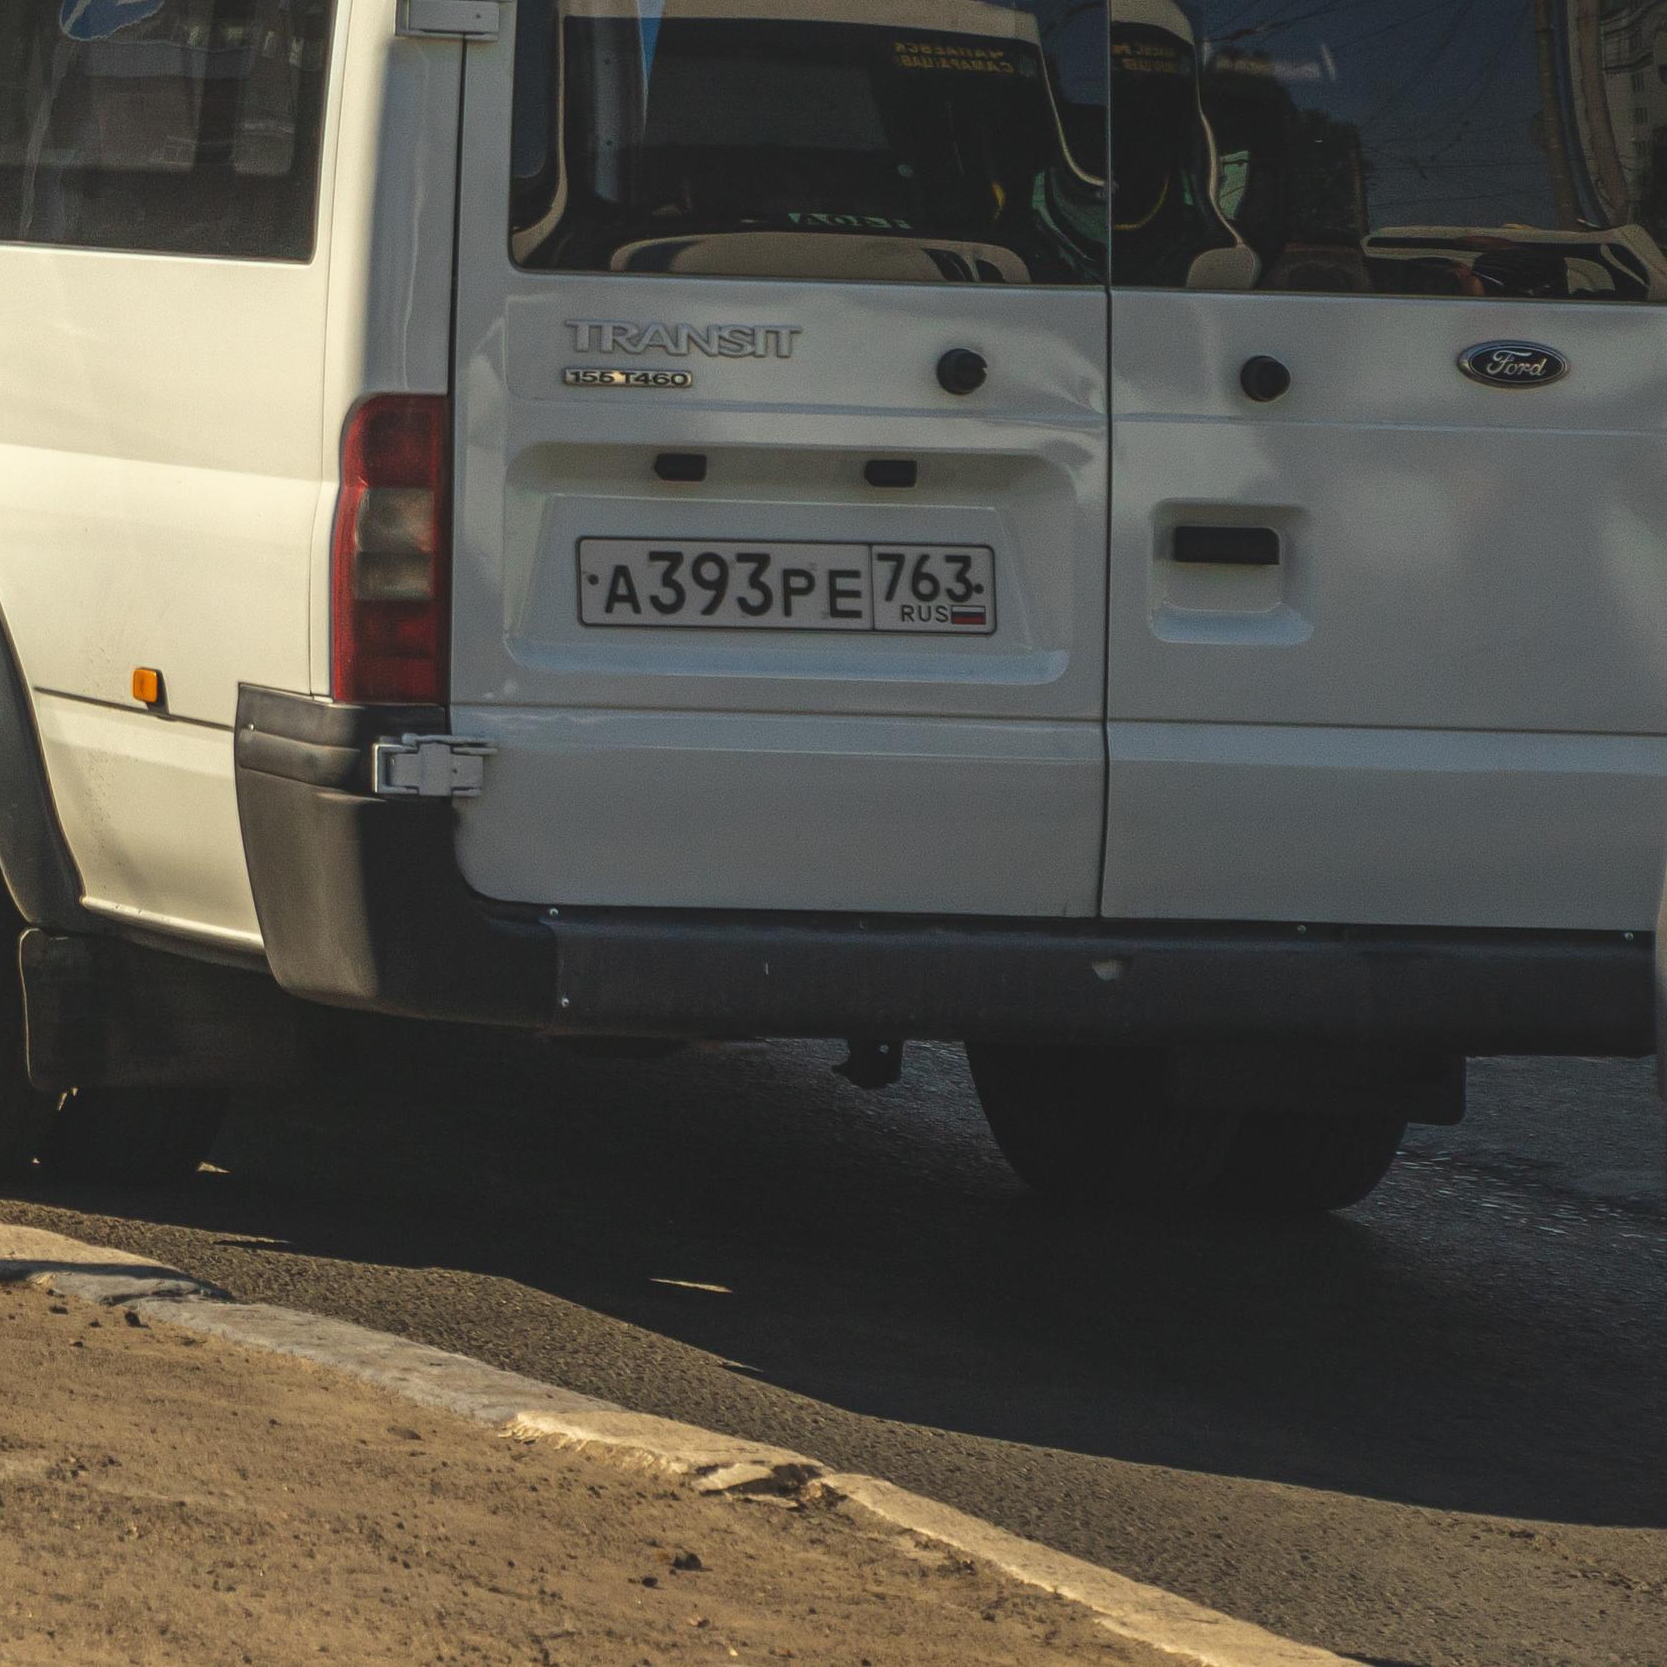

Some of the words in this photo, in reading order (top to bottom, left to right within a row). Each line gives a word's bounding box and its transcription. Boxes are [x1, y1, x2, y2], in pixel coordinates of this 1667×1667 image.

[565, 318, 803, 359] TRANSIT
[1486, 349, 1548, 376] Ford
[620, 371, 690, 385] T460
[605, 551, 863, 618] А393РЕ
[876, 553, 973, 603] 763
[901, 605, 948, 623] RUS
